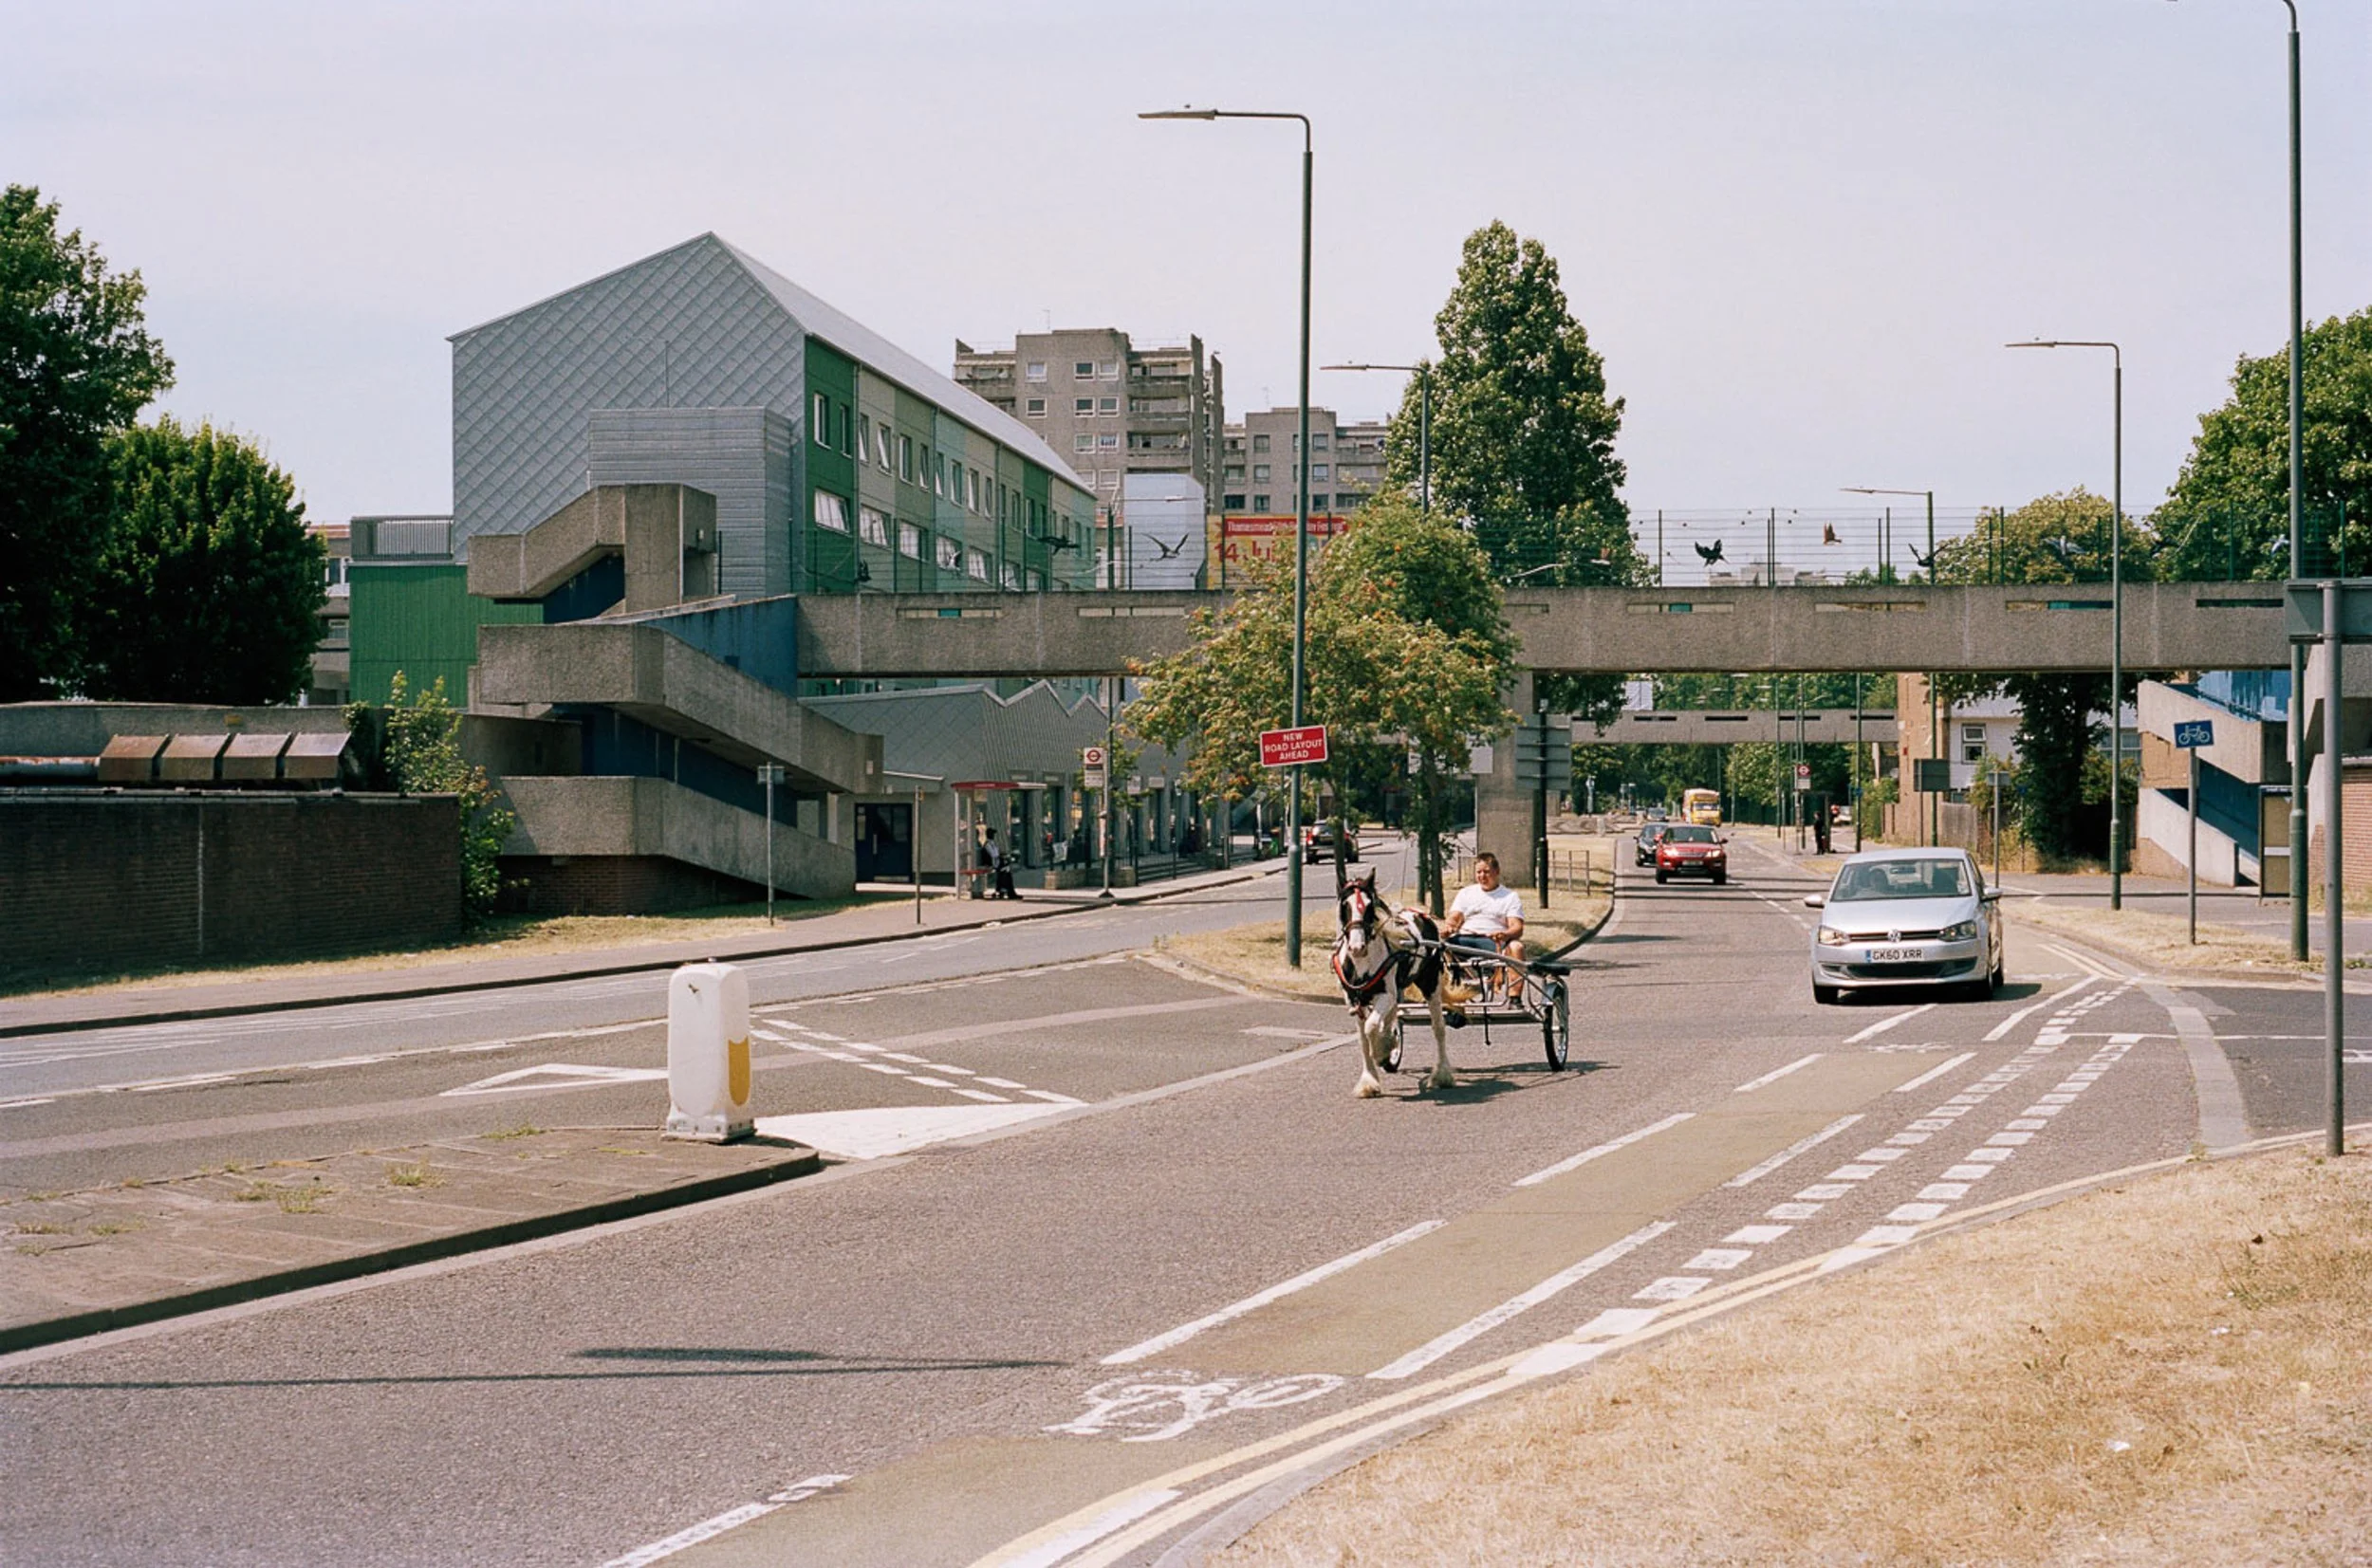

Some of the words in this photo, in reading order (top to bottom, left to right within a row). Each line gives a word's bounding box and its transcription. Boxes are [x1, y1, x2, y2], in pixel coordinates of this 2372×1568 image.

[1214, 543, 1239, 563] 14
[1283, 731, 1305, 742] NEW
[1264, 742, 1289, 753] ROAD
[1290, 738, 1323, 750] LAYOUT
[1279, 749, 1309, 761] AHEAD
[1902, 949, 1922, 959] XRR
